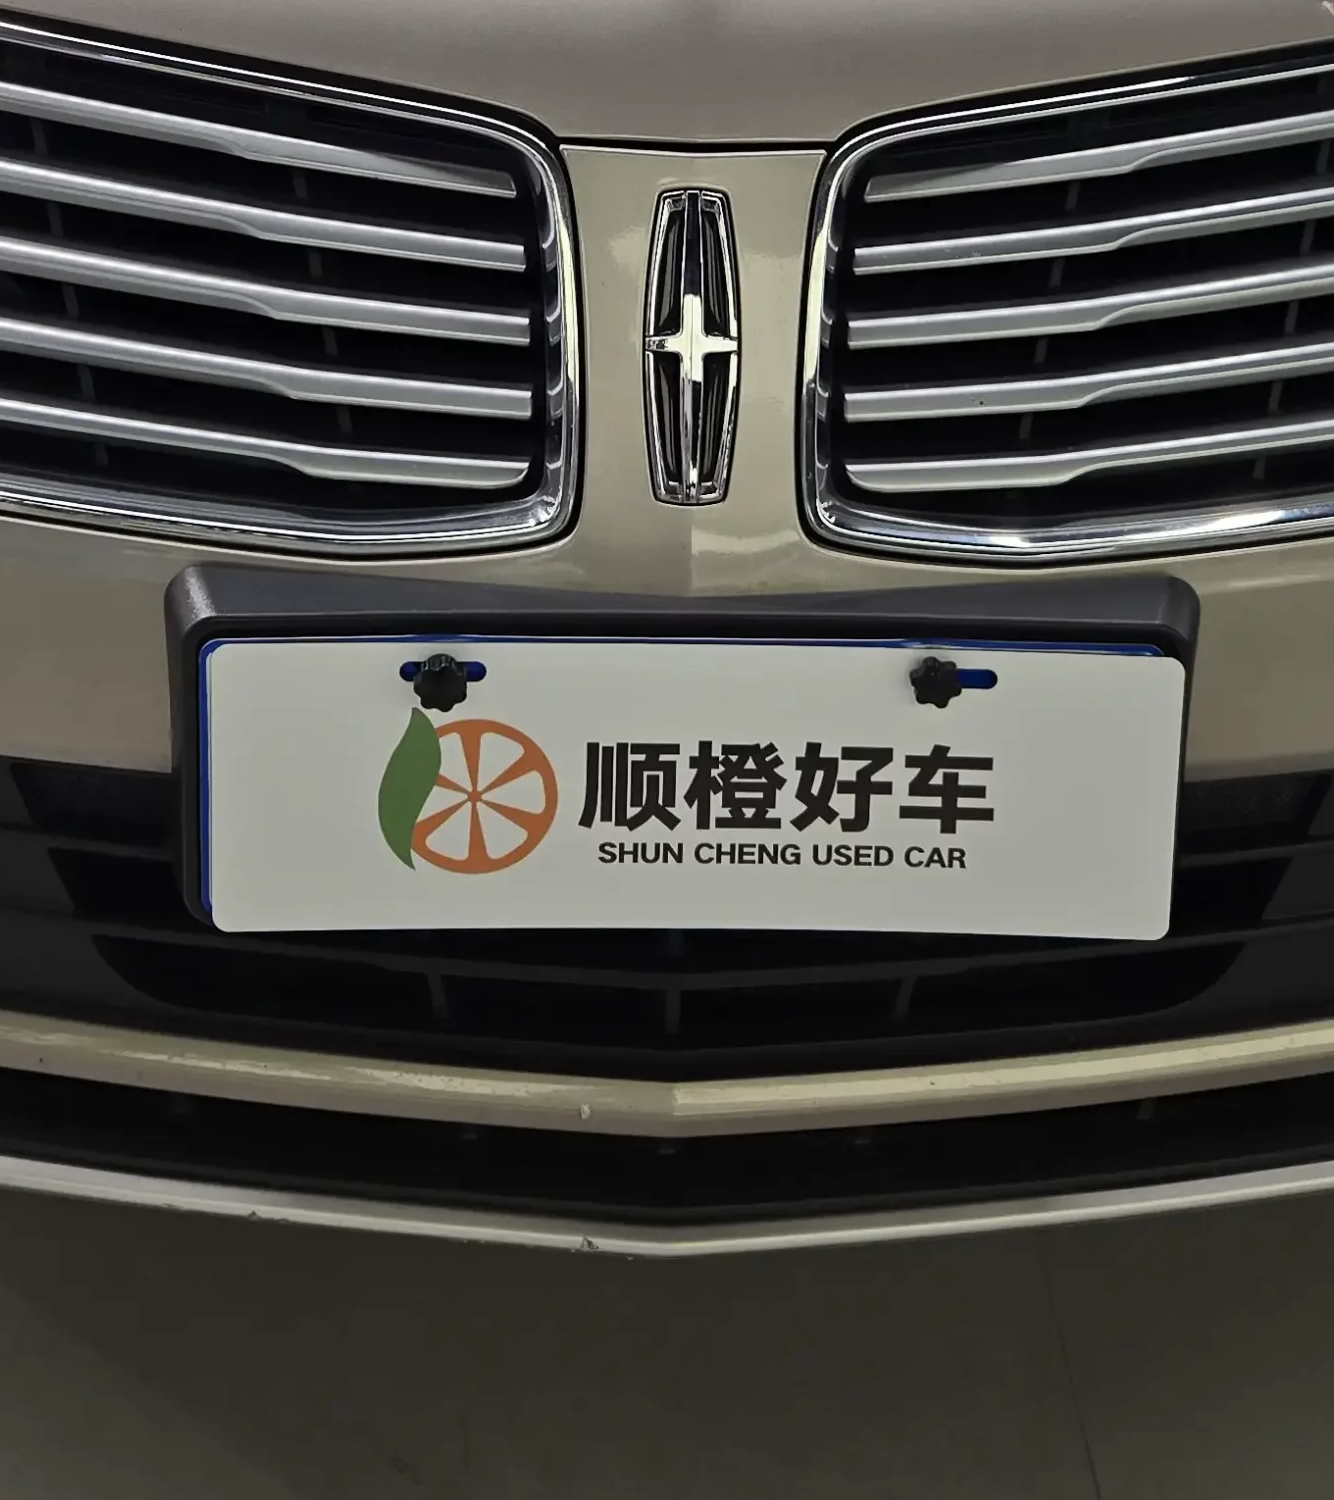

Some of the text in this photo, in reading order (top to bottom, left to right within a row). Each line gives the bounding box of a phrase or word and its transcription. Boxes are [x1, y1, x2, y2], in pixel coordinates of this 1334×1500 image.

[578, 740, 995, 835] 顺橙好车
[598, 841, 967, 869] SHUN CHENG USED CAR
